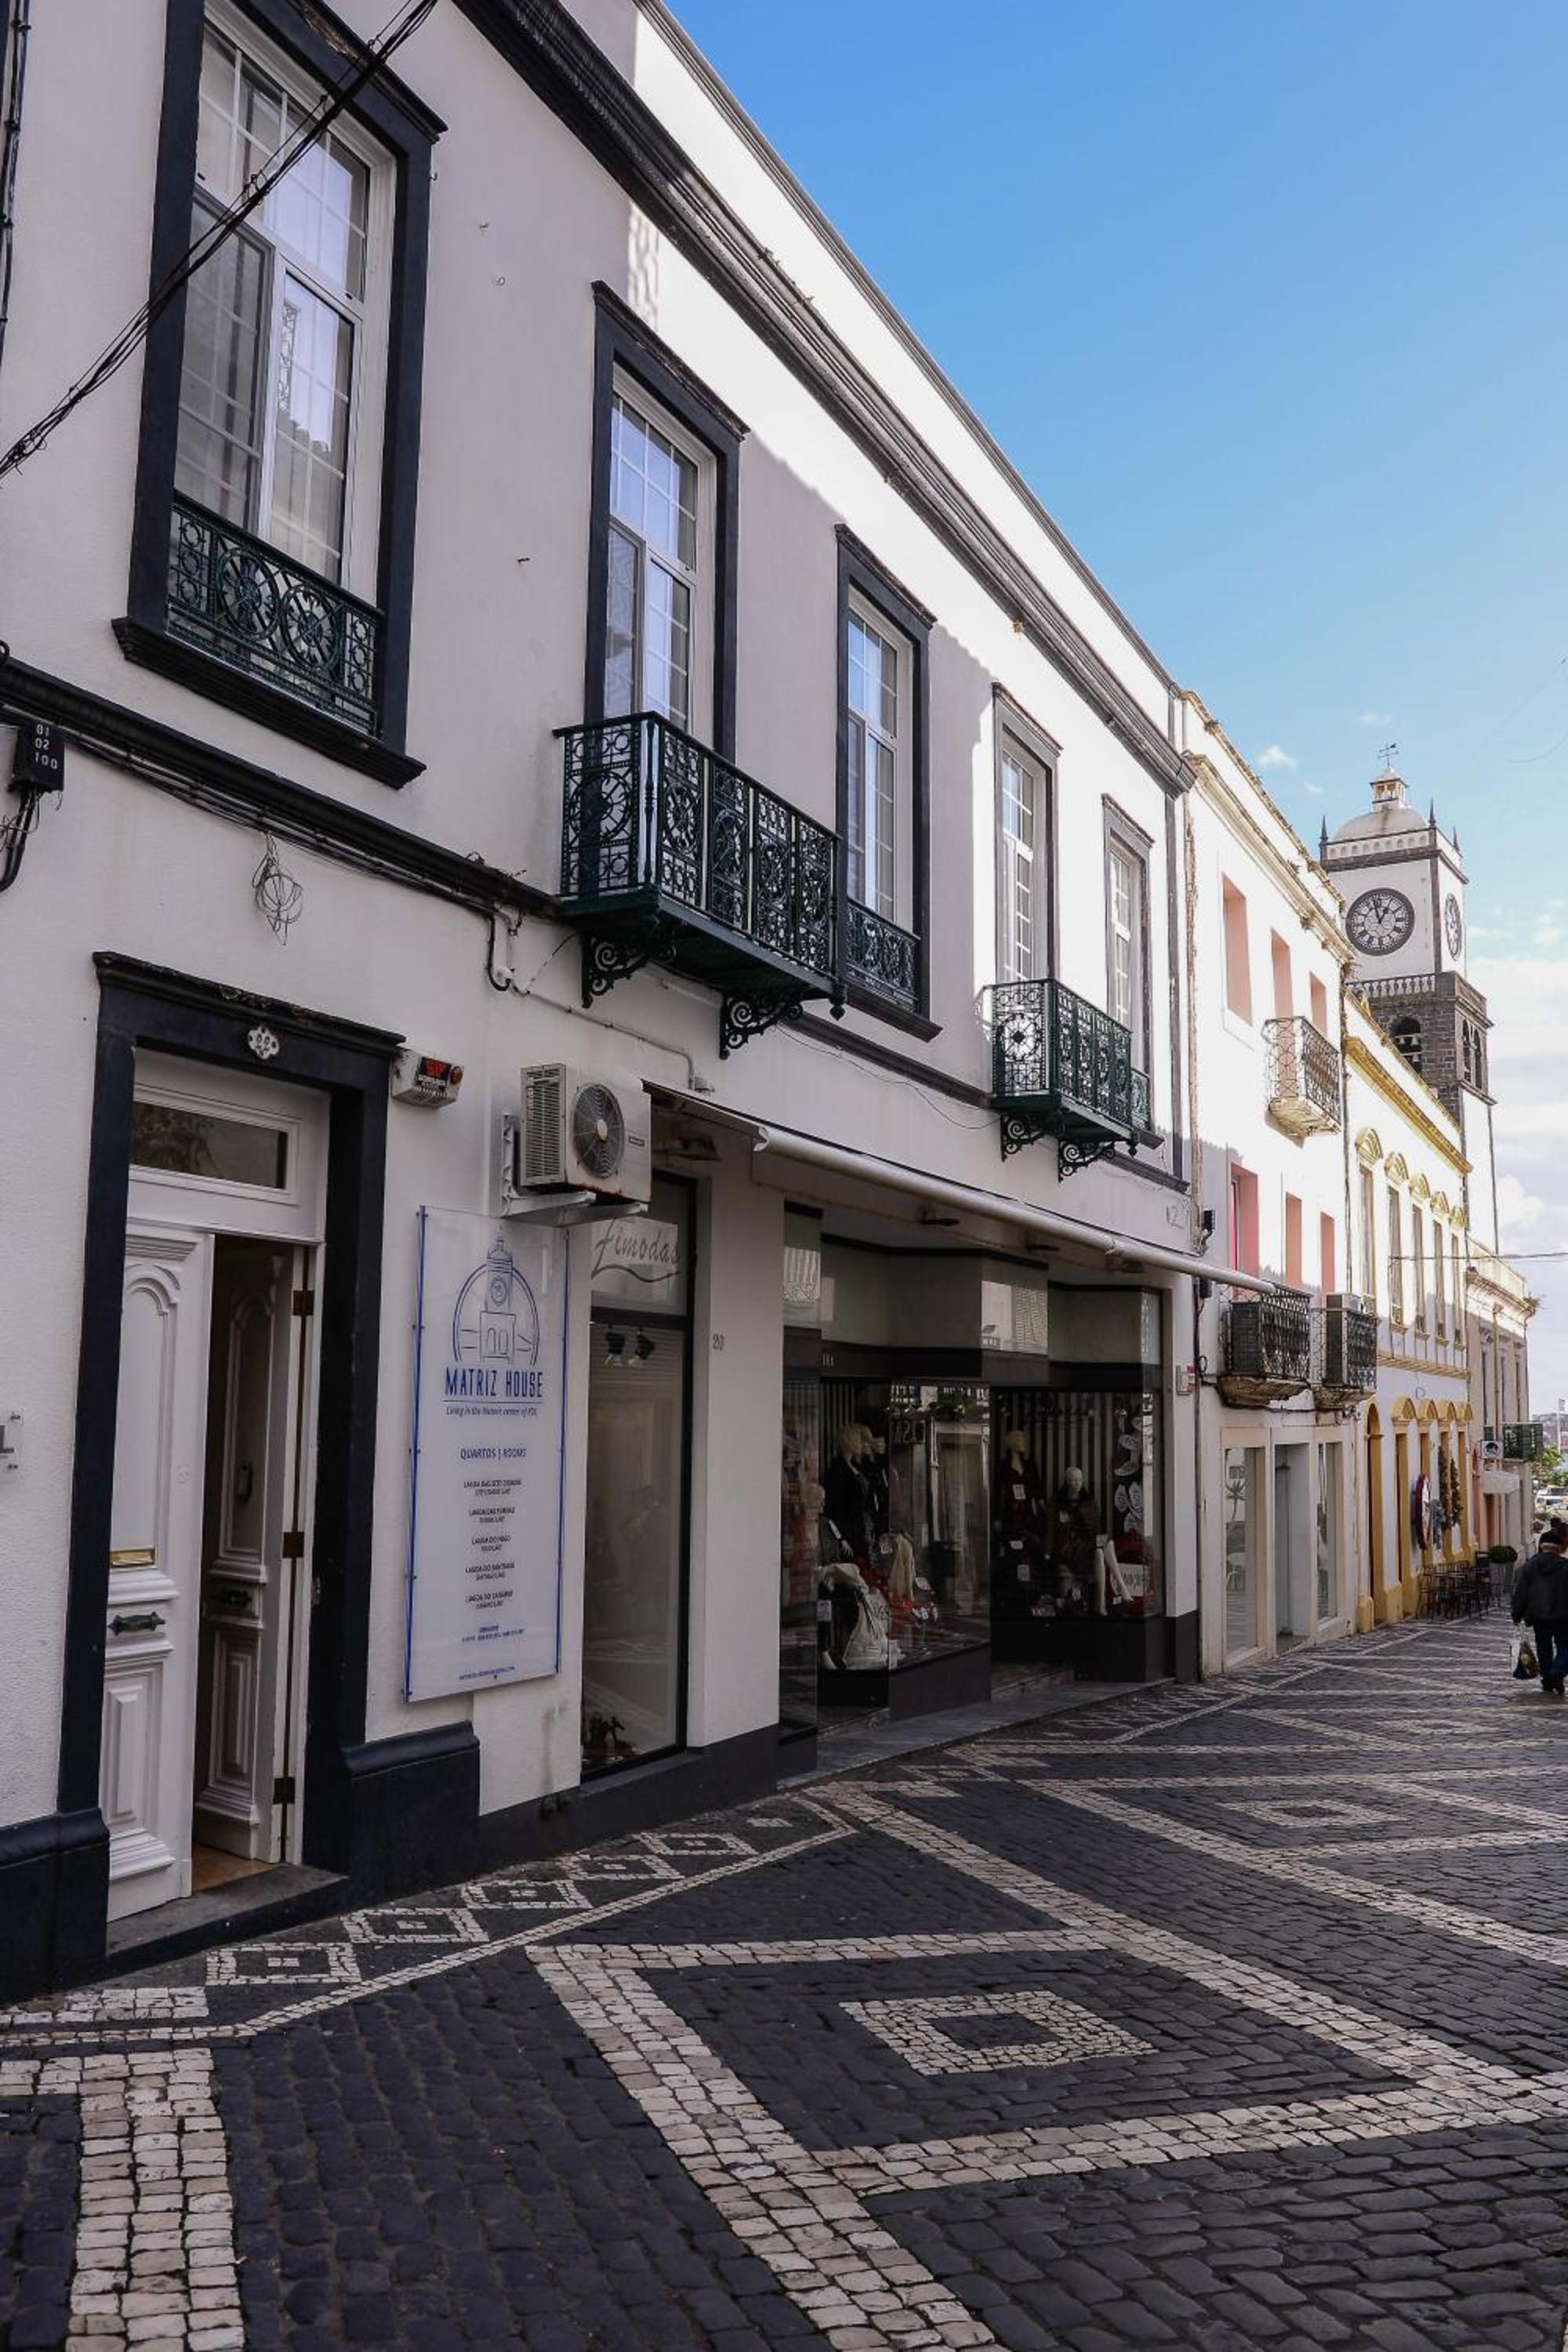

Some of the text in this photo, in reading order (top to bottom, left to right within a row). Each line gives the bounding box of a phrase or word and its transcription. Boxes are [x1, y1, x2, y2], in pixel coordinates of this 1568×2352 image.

[36, 724, 49, 737] 01
[35, 738, 49, 750] 02
[35, 752, 58, 769] 100
[445, 1367, 543, 1398] MATRIZ HOUSE
[460, 1448, 496, 1461] QUARTOS
